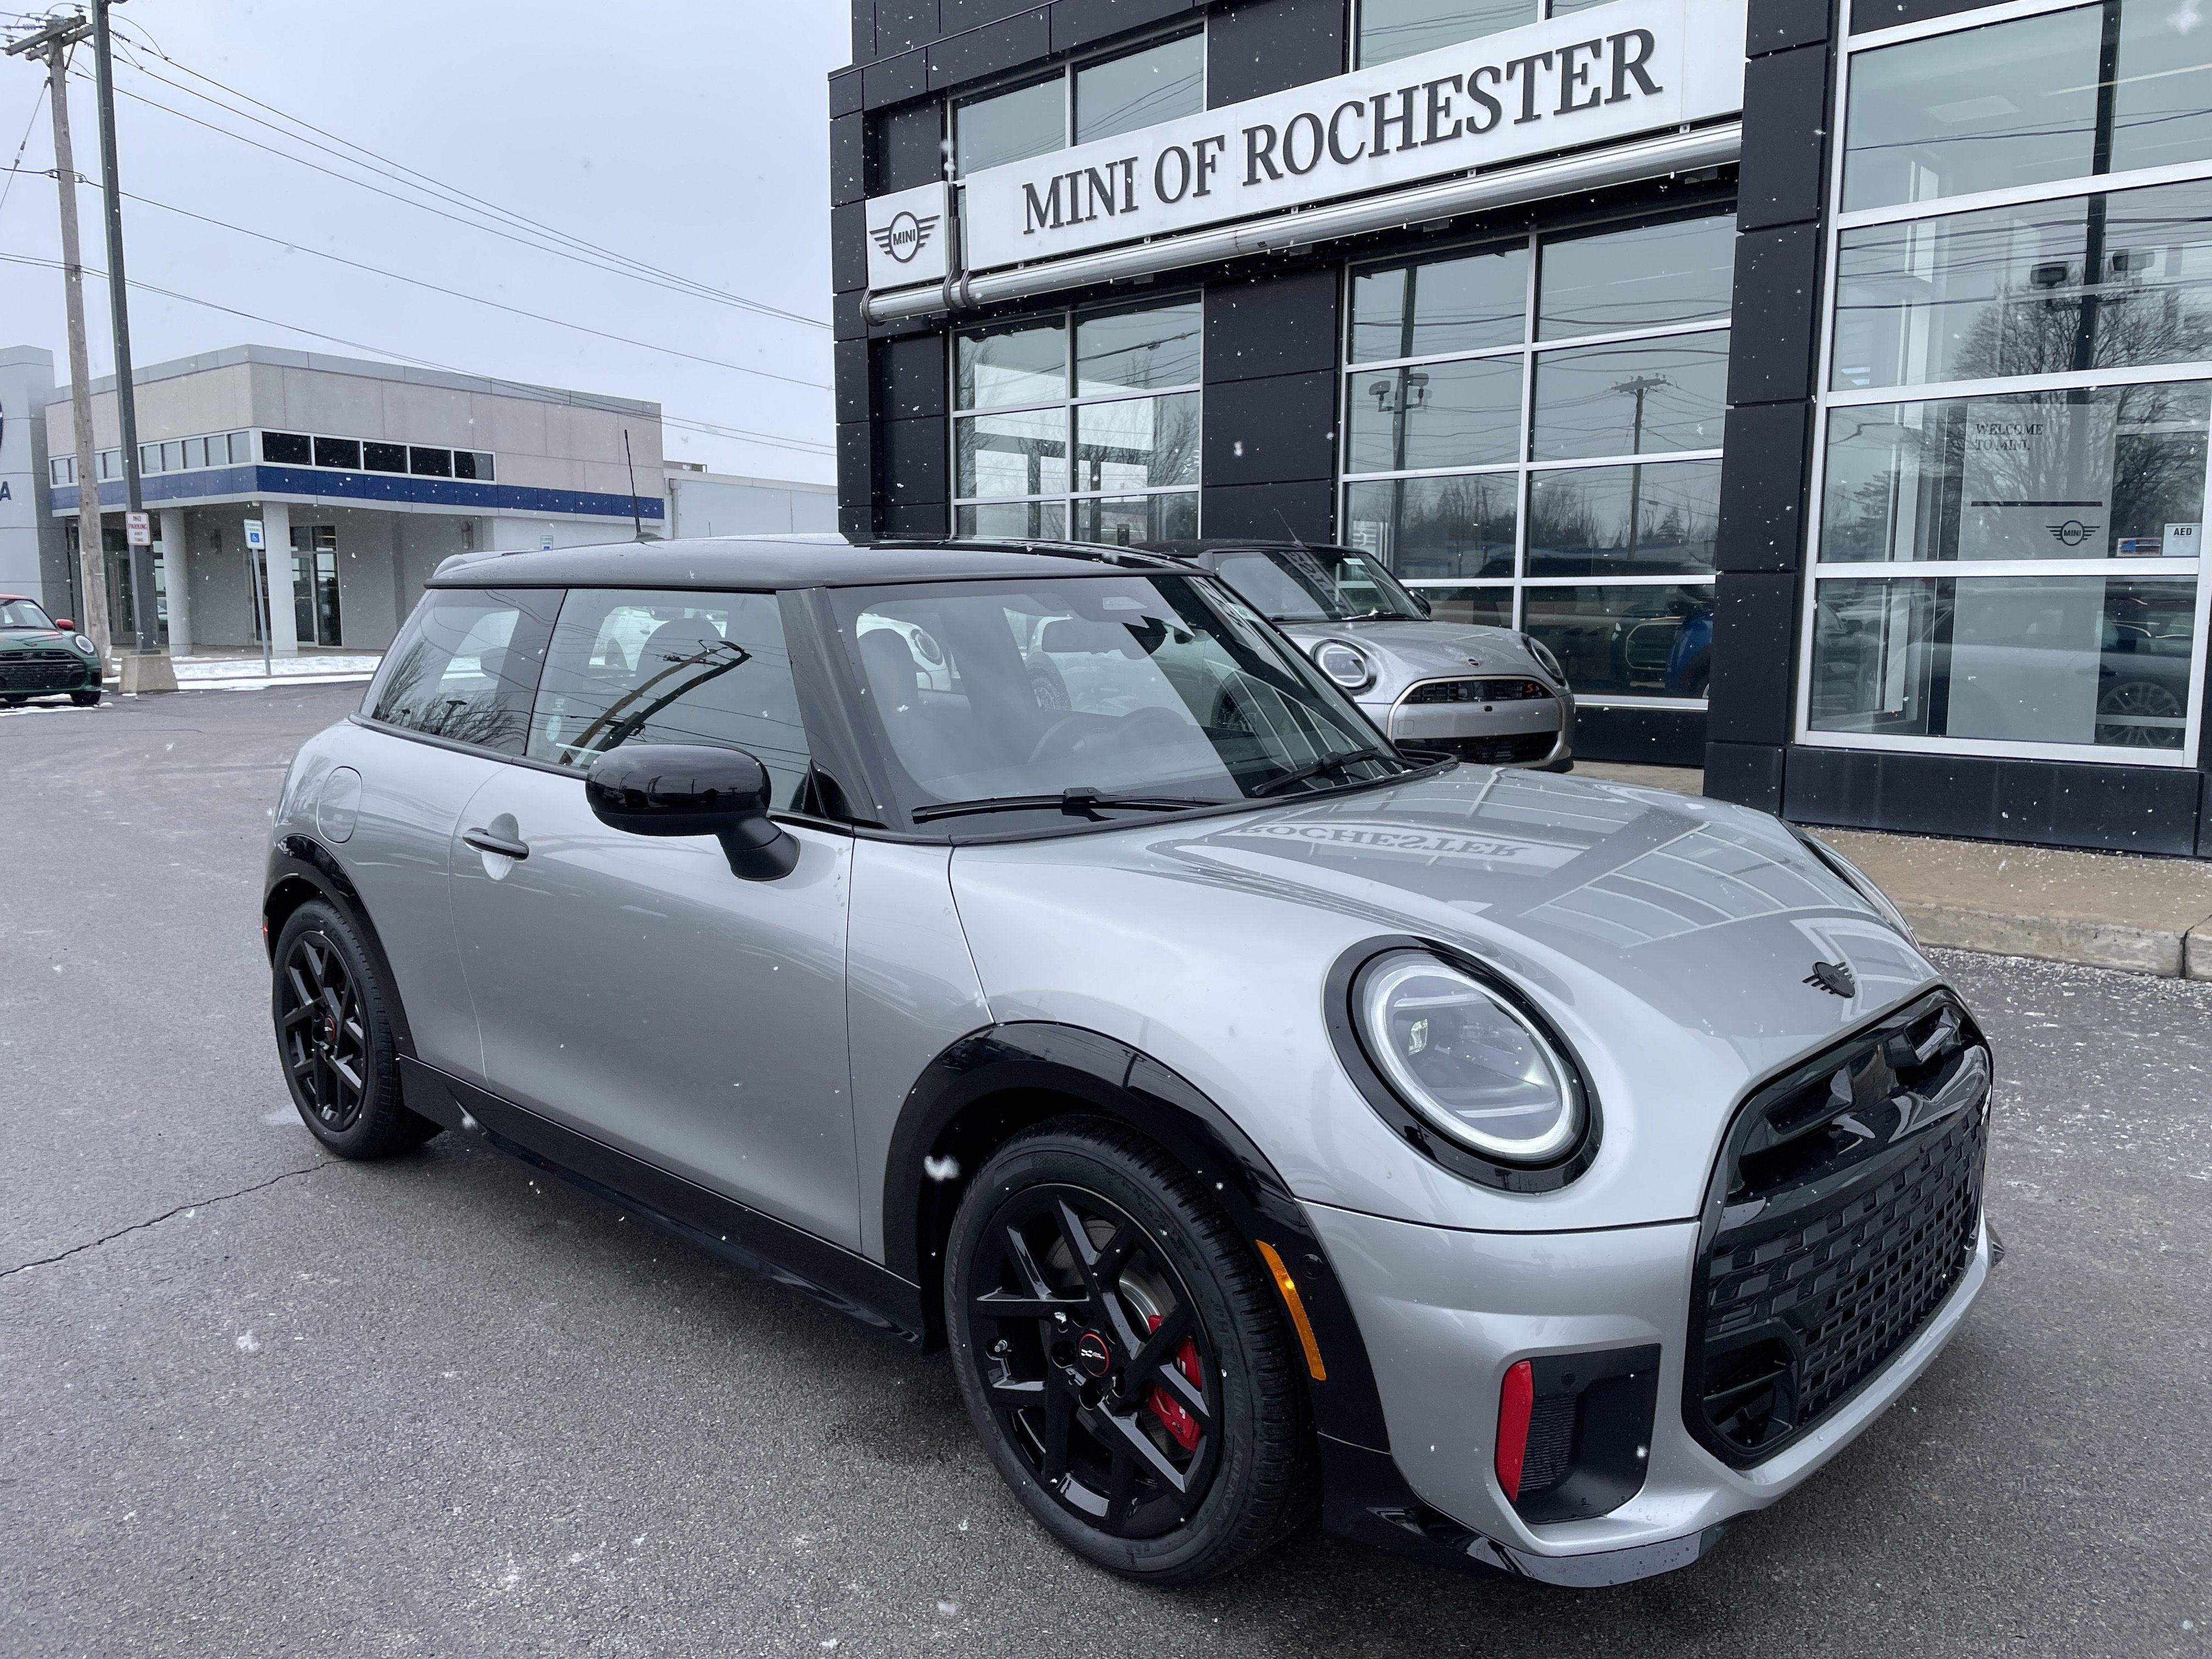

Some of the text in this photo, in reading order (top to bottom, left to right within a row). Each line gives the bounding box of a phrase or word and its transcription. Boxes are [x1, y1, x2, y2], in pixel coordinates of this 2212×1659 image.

[1022, 28, 1663, 235] MINI OF ROCHESTER
[893, 229, 916, 245] MINI
[1976, 424, 2043, 435] WELCOME
[1976, 439, 1993, 450] TO
[1525, 684, 1533, 692] S
